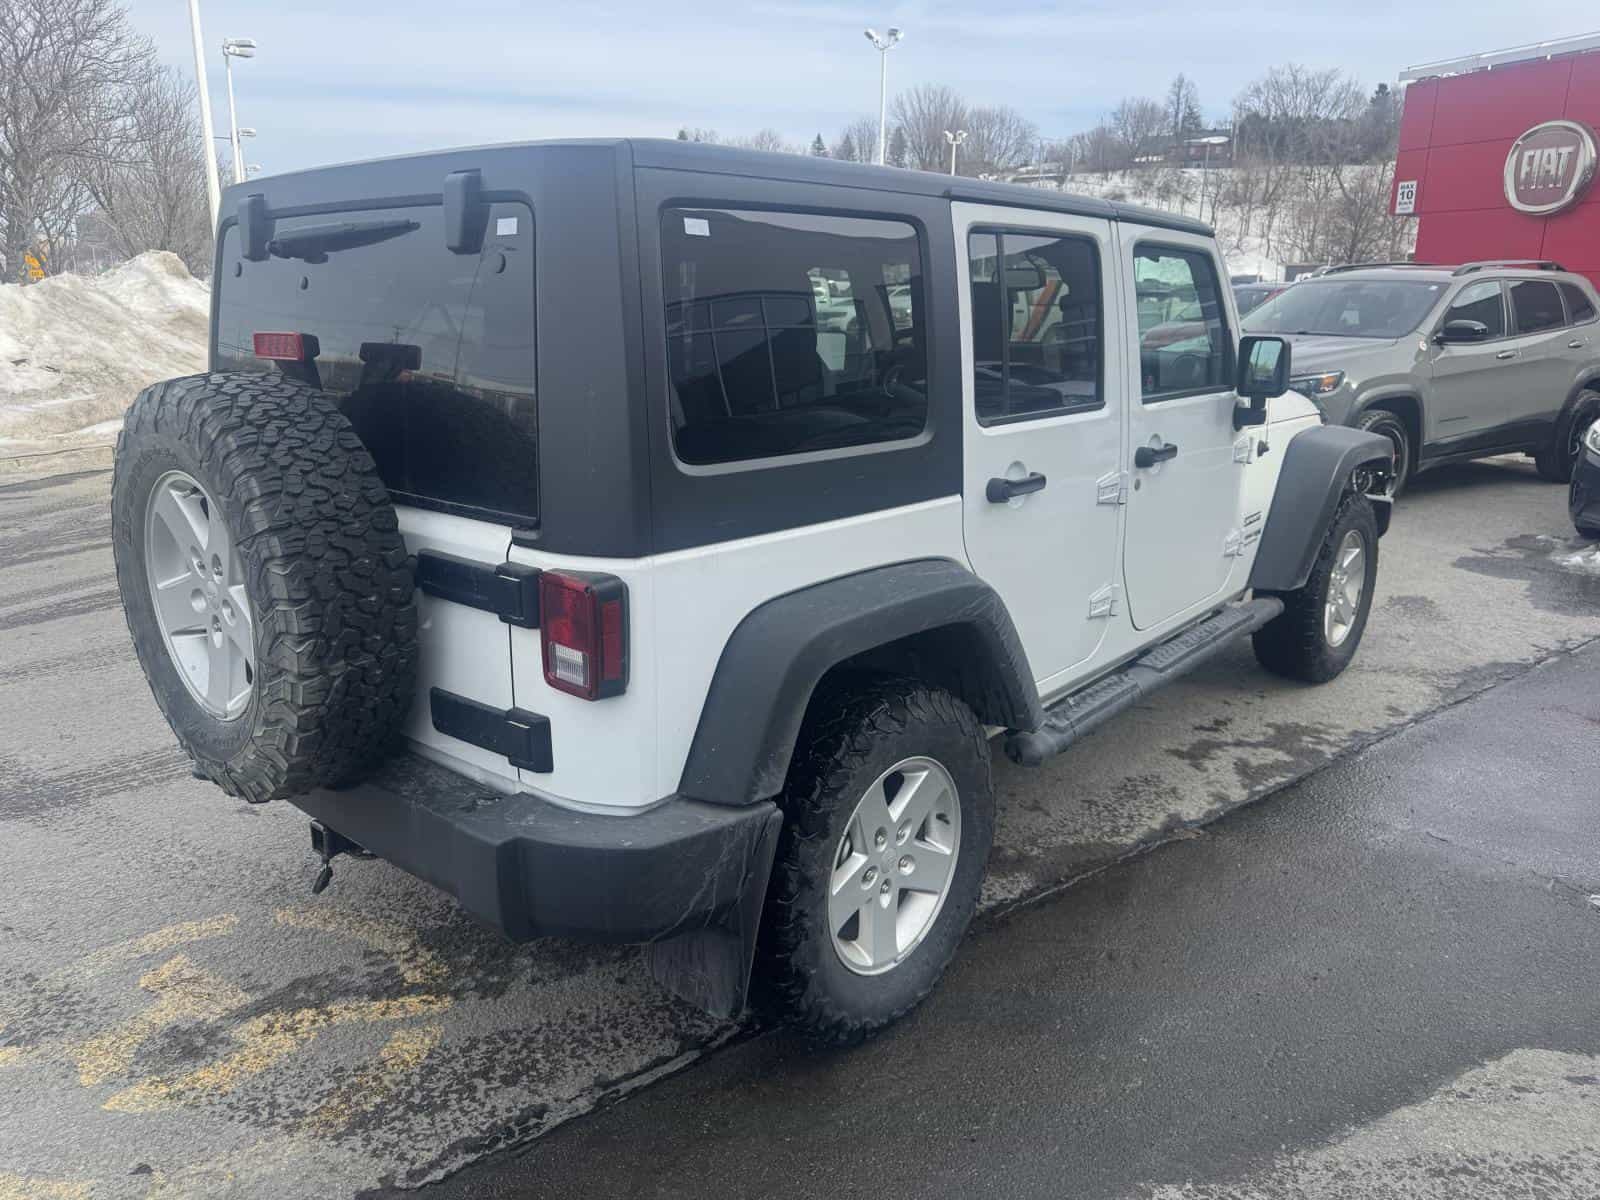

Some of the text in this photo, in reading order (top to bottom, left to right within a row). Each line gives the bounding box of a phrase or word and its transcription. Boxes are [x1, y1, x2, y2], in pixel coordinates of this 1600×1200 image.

[1518, 145, 1576, 190] FIAT
[1400, 183, 1415, 191] MAX
[1399, 190, 1414, 201] 10
